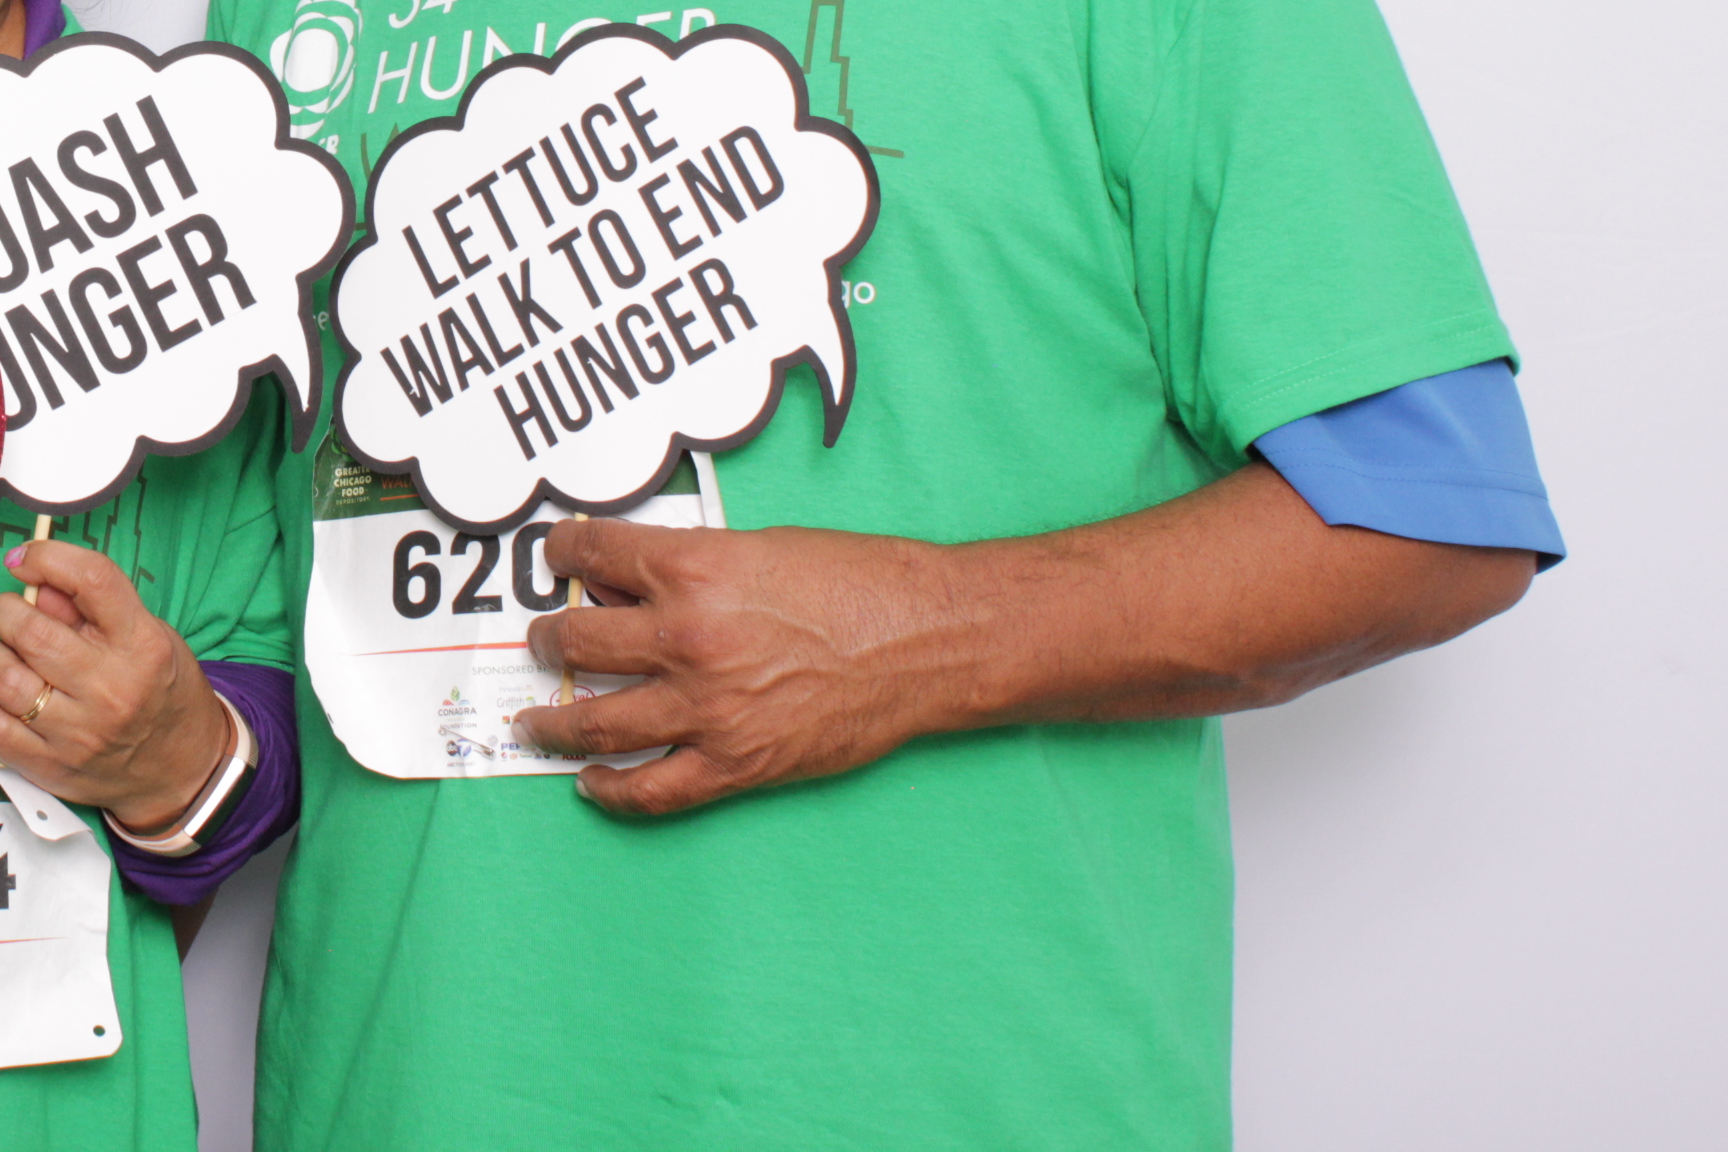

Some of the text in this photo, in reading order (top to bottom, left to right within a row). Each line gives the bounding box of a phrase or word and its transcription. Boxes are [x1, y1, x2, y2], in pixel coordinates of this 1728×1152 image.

[402, 76, 679, 299] LETTUCE
[380, 126, 784, 417] WALK TO END
[493, 258, 758, 462] HUNGER
[334, 475, 372, 488] CHICAGO
[380, 475, 412, 490] WAL
[341, 487, 365, 497] FOOD
[392, 521, 605, 619] 620
[472, 665, 534, 675] SPONSORED
[497, 697, 525, 710] Griffith
[438, 707, 477, 717] CONAGRA
